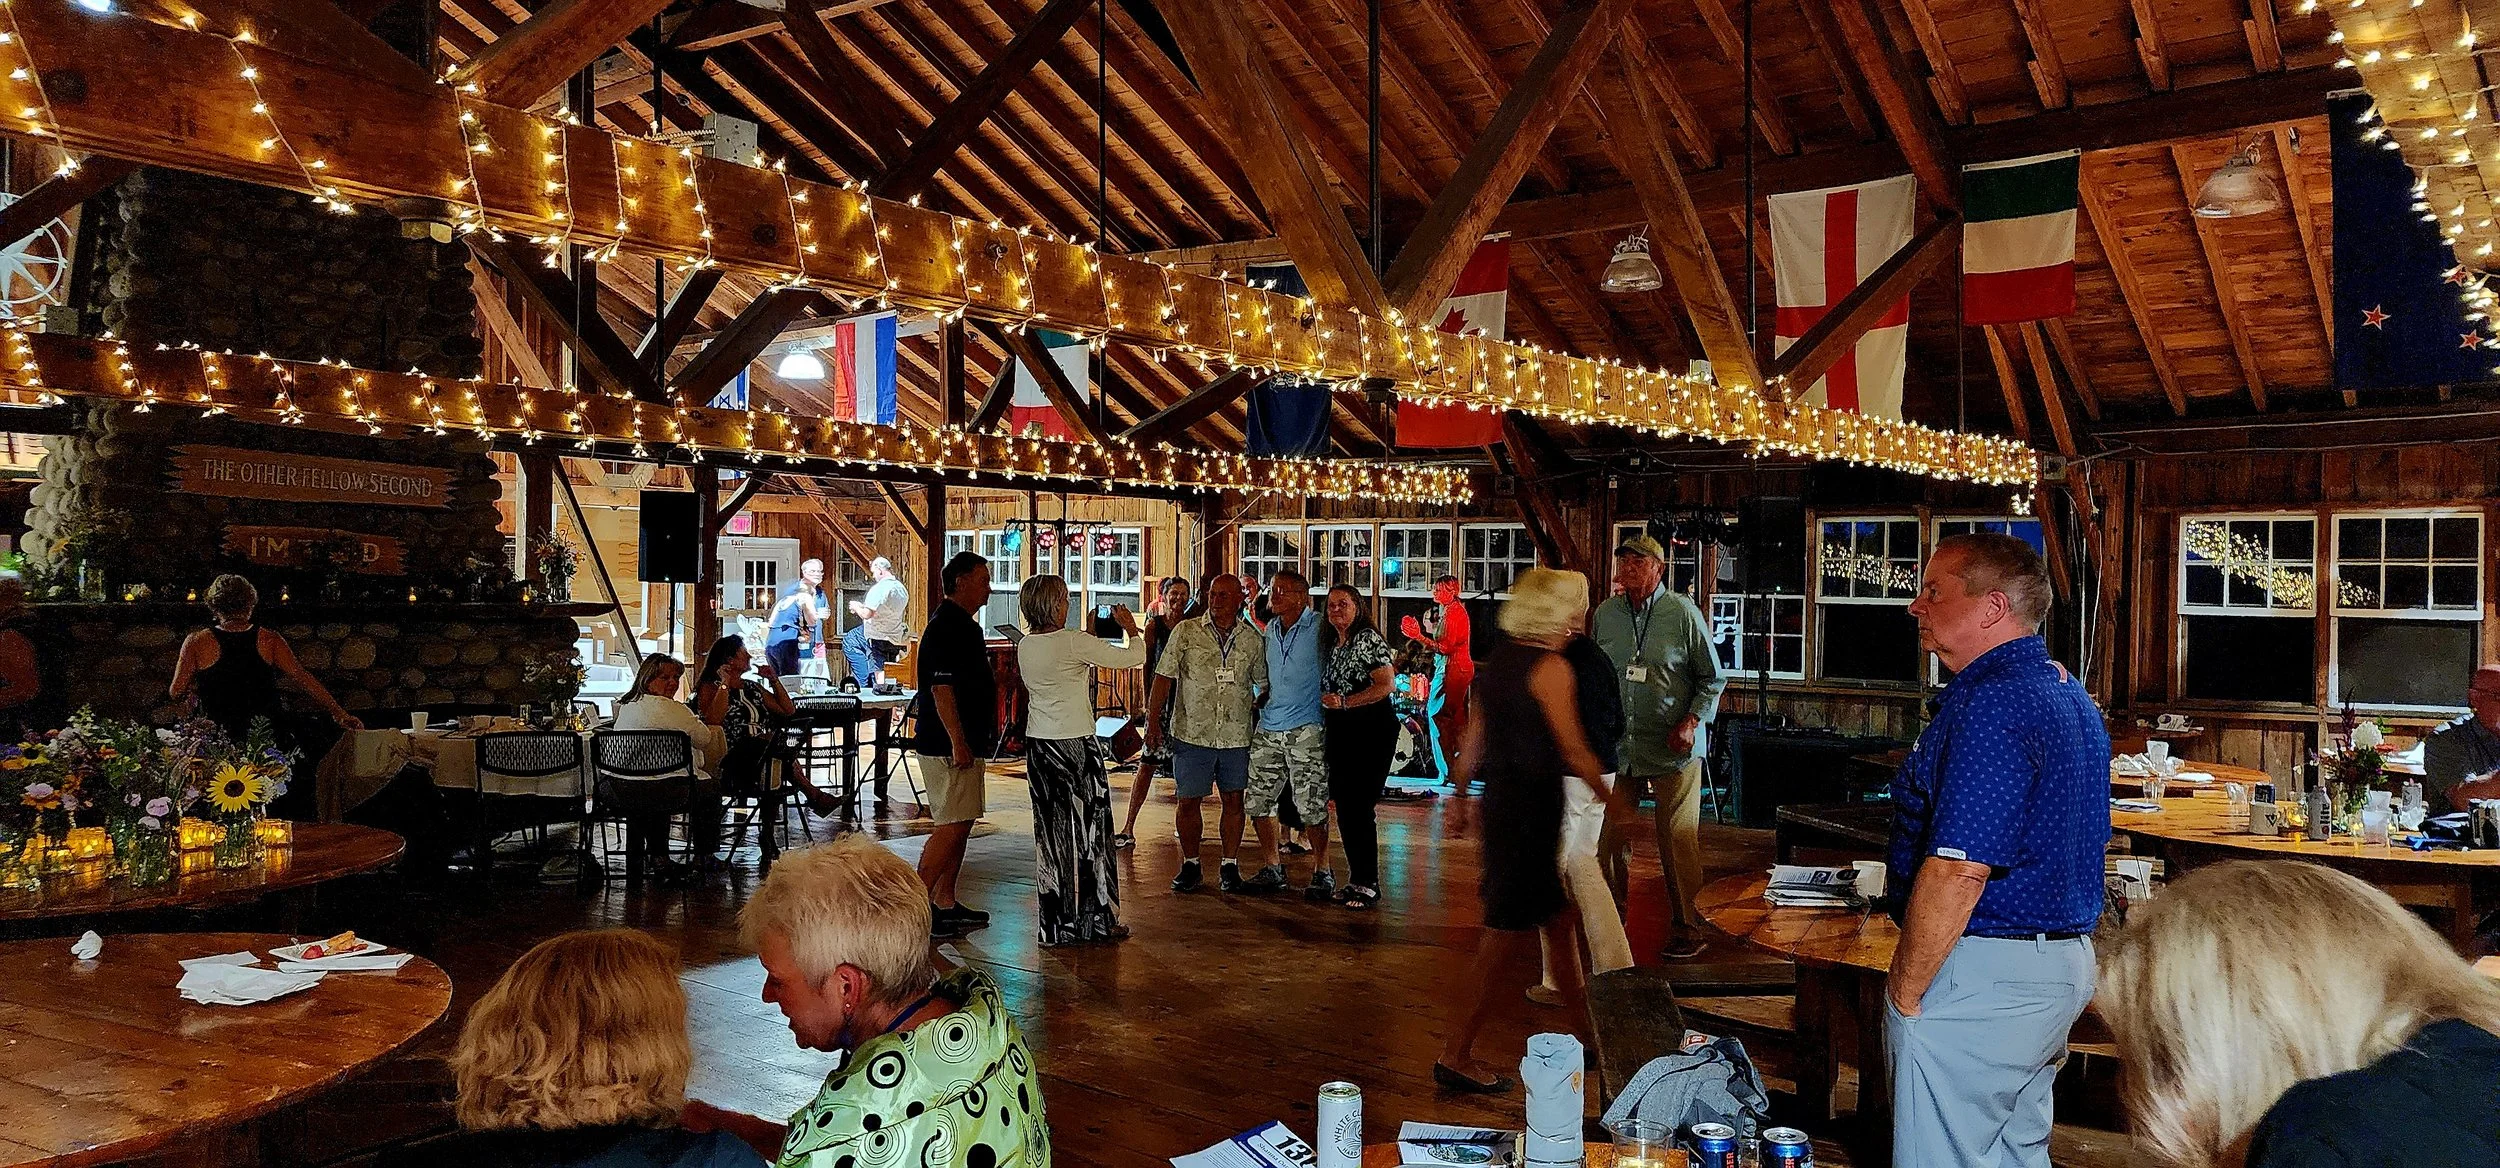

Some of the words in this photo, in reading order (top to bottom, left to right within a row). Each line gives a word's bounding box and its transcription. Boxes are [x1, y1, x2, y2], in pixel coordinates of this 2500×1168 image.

[202, 458, 235, 481] THE
[240, 462, 297, 487] OTHER
[301, 467, 366, 491] FELLOW
[369, 472, 433, 498] SECOND
[1334, 1114, 1351, 1143] WHITE
